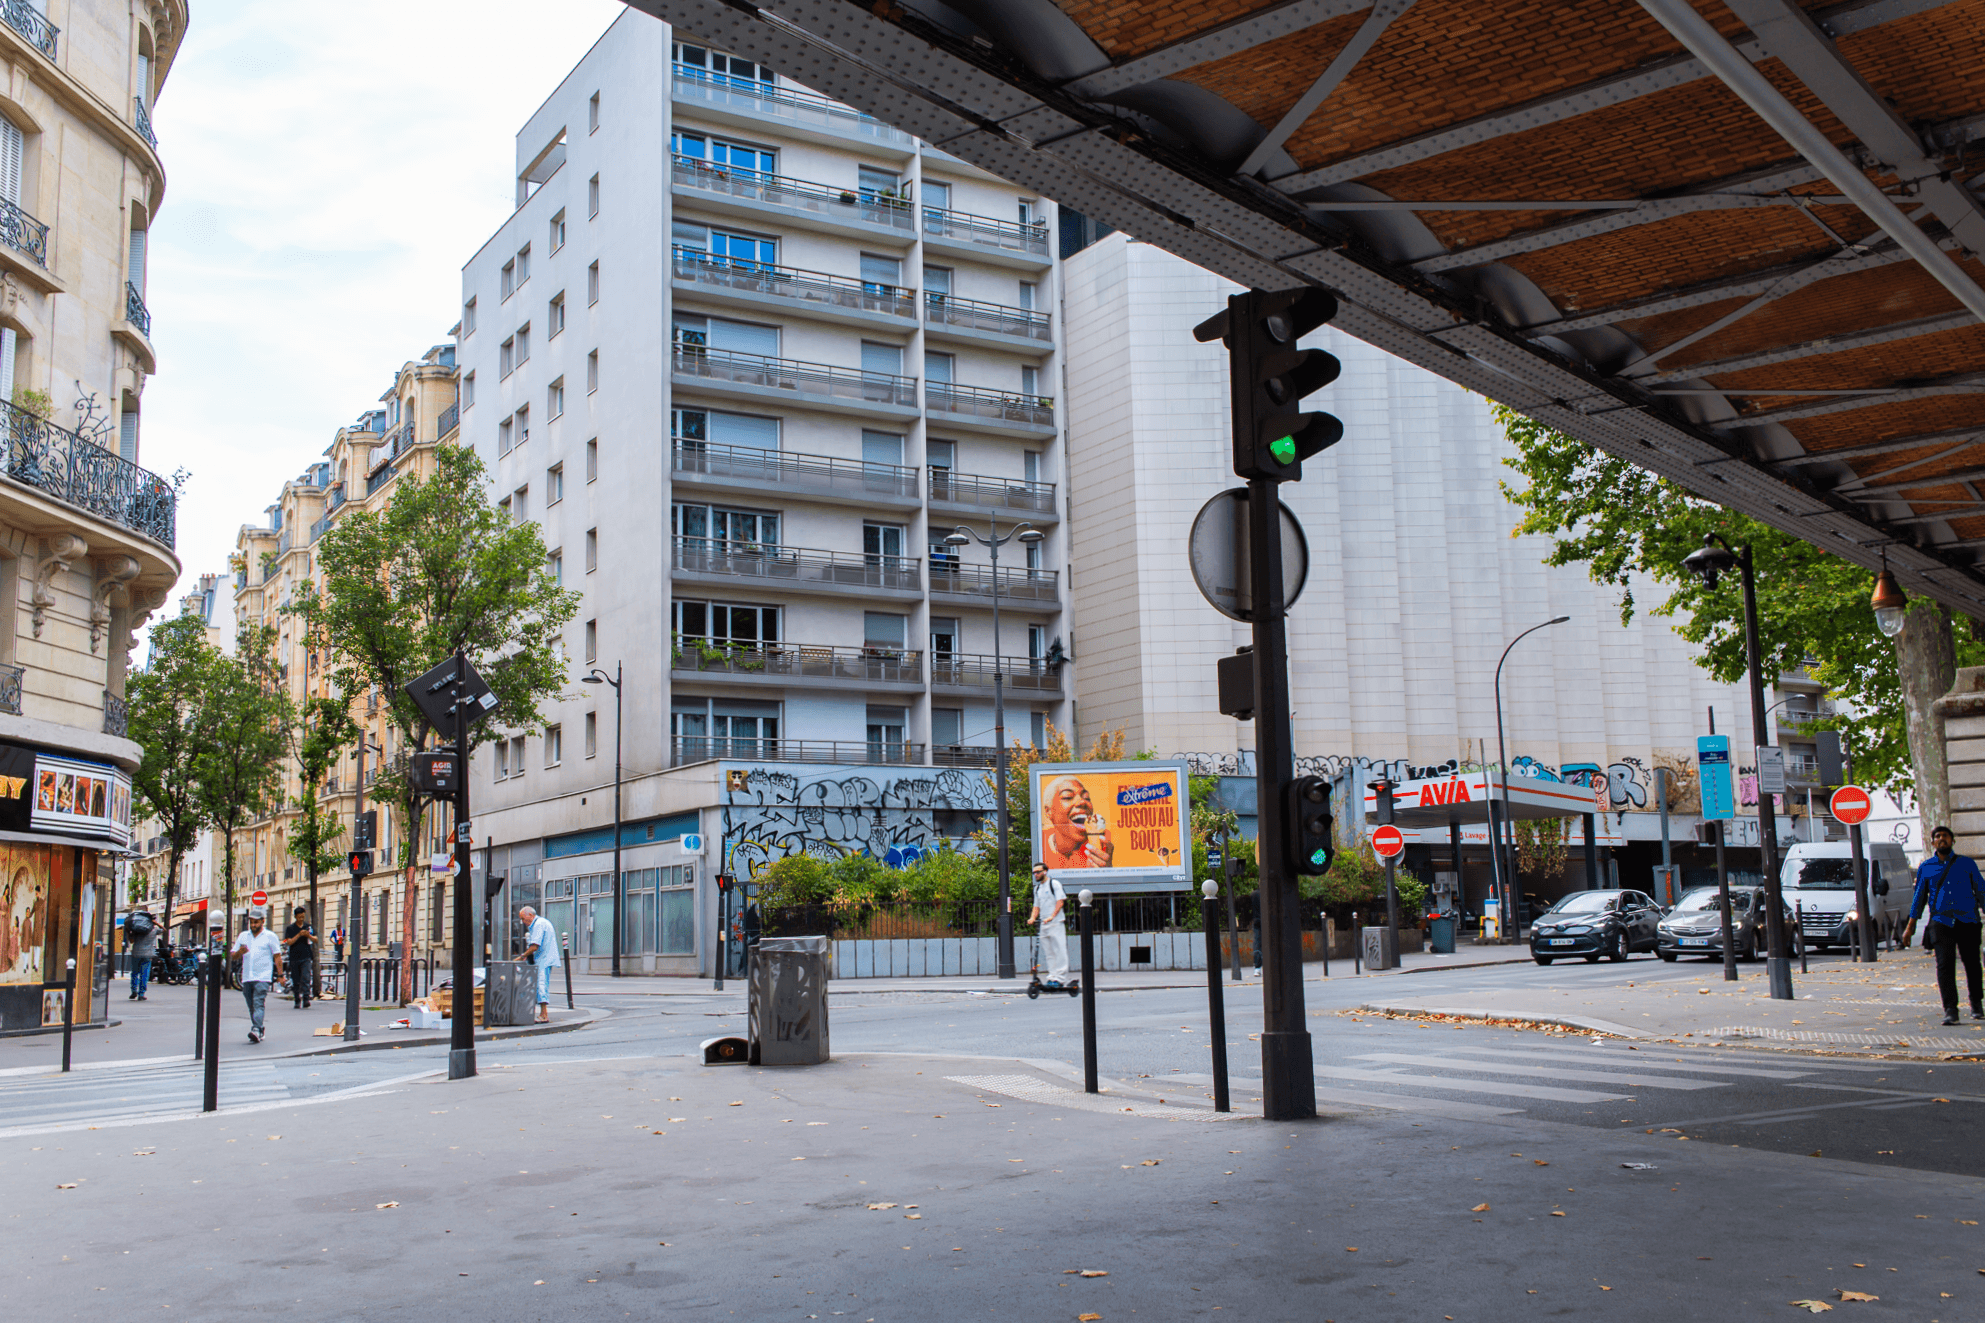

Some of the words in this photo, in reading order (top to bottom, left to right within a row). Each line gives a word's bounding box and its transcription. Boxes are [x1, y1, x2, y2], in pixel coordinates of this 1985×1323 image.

[1117, 806, 1174, 829] JUSQU'AU
[1130, 829, 1162, 851] BOUT
[1465, 832, 1487, 841] Lavage
